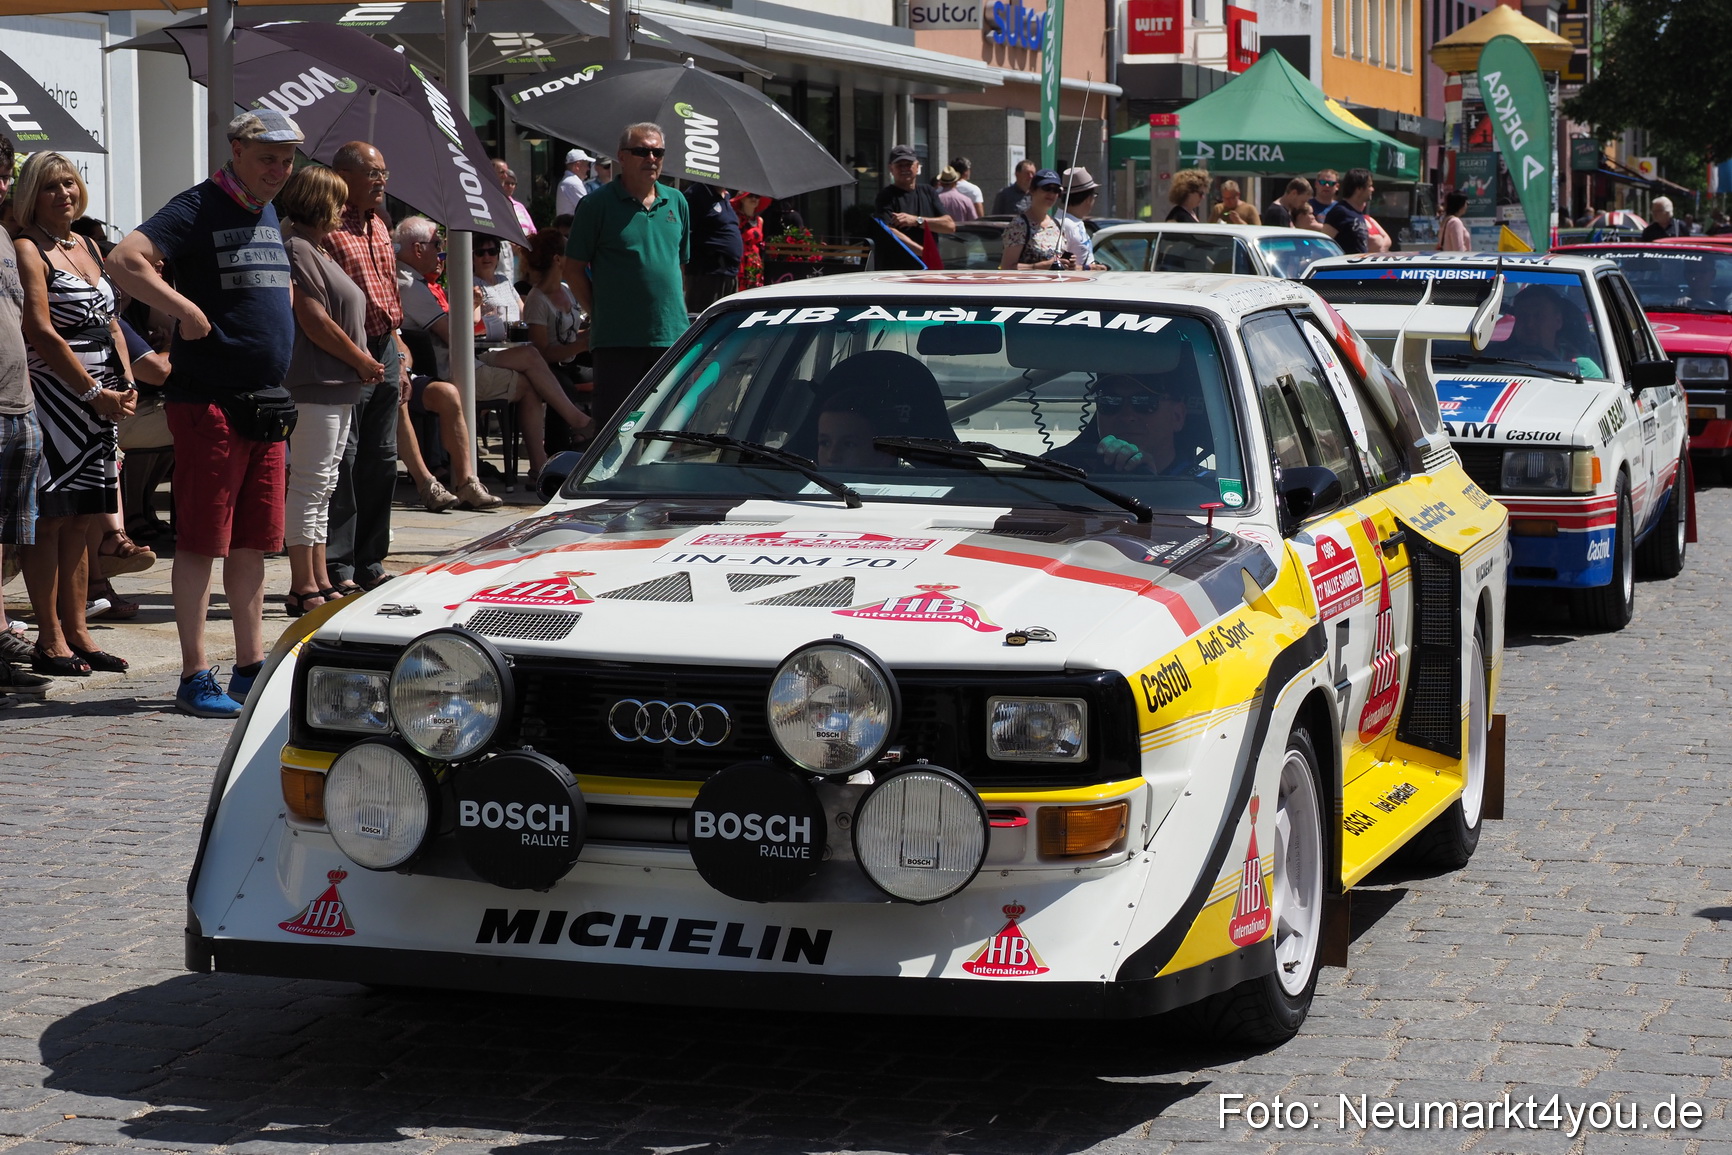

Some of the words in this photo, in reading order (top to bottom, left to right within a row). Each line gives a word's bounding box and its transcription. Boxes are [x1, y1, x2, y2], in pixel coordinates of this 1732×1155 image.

[911, 3, 978, 24] sutor.
[1135, 17, 1174, 32] WITT
[519, 69, 596, 102] now
[684, 111, 720, 173] now
[1221, 143, 1285, 162] DEKRA
[223, 229, 279, 243] HILFIGE
[229, 250, 278, 264] DENIM
[1642, 252, 1703, 262] Mitsubishi
[232, 272, 277, 286] USA
[1401, 269, 1486, 280] MITSUBISHI
[737, 307, 839, 329] HB
[851, 304, 978, 323] Audi
[989, 307, 1172, 333] TEAM
[1505, 429, 1562, 442] Castrol
[1587, 539, 1610, 562] Castrol
[671, 553, 832, 567] IN-NM
[842, 557, 899, 569] 70
[487, 581, 578, 599] HB
[471, 594, 574, 605] ternational
[881, 597, 967, 613] HB
[852, 611, 981, 630] international
[1140, 654, 1192, 714] Castrol
[1195, 629, 1228, 666] Audi
[1215, 617, 1255, 650] Sport
[433, 716, 461, 725] BOSCH
[815, 730, 841, 740] BOSCH
[459, 800, 570, 833] BOSCH
[361, 826, 382, 836] BOSCH
[694, 810, 811, 844] BOSCH
[520, 833, 570, 848] RALLYE
[759, 844, 811, 860] RALLYE
[907, 857, 932, 867] BOSCH
[1241, 857, 1261, 917] HB
[302, 900, 345, 928] HB
[285, 924, 346, 937] international
[1233, 913, 1268, 941] international
[475, 907, 834, 966] MICHELIN
[986, 936, 1032, 966] HB
[972, 965, 1039, 977] international
